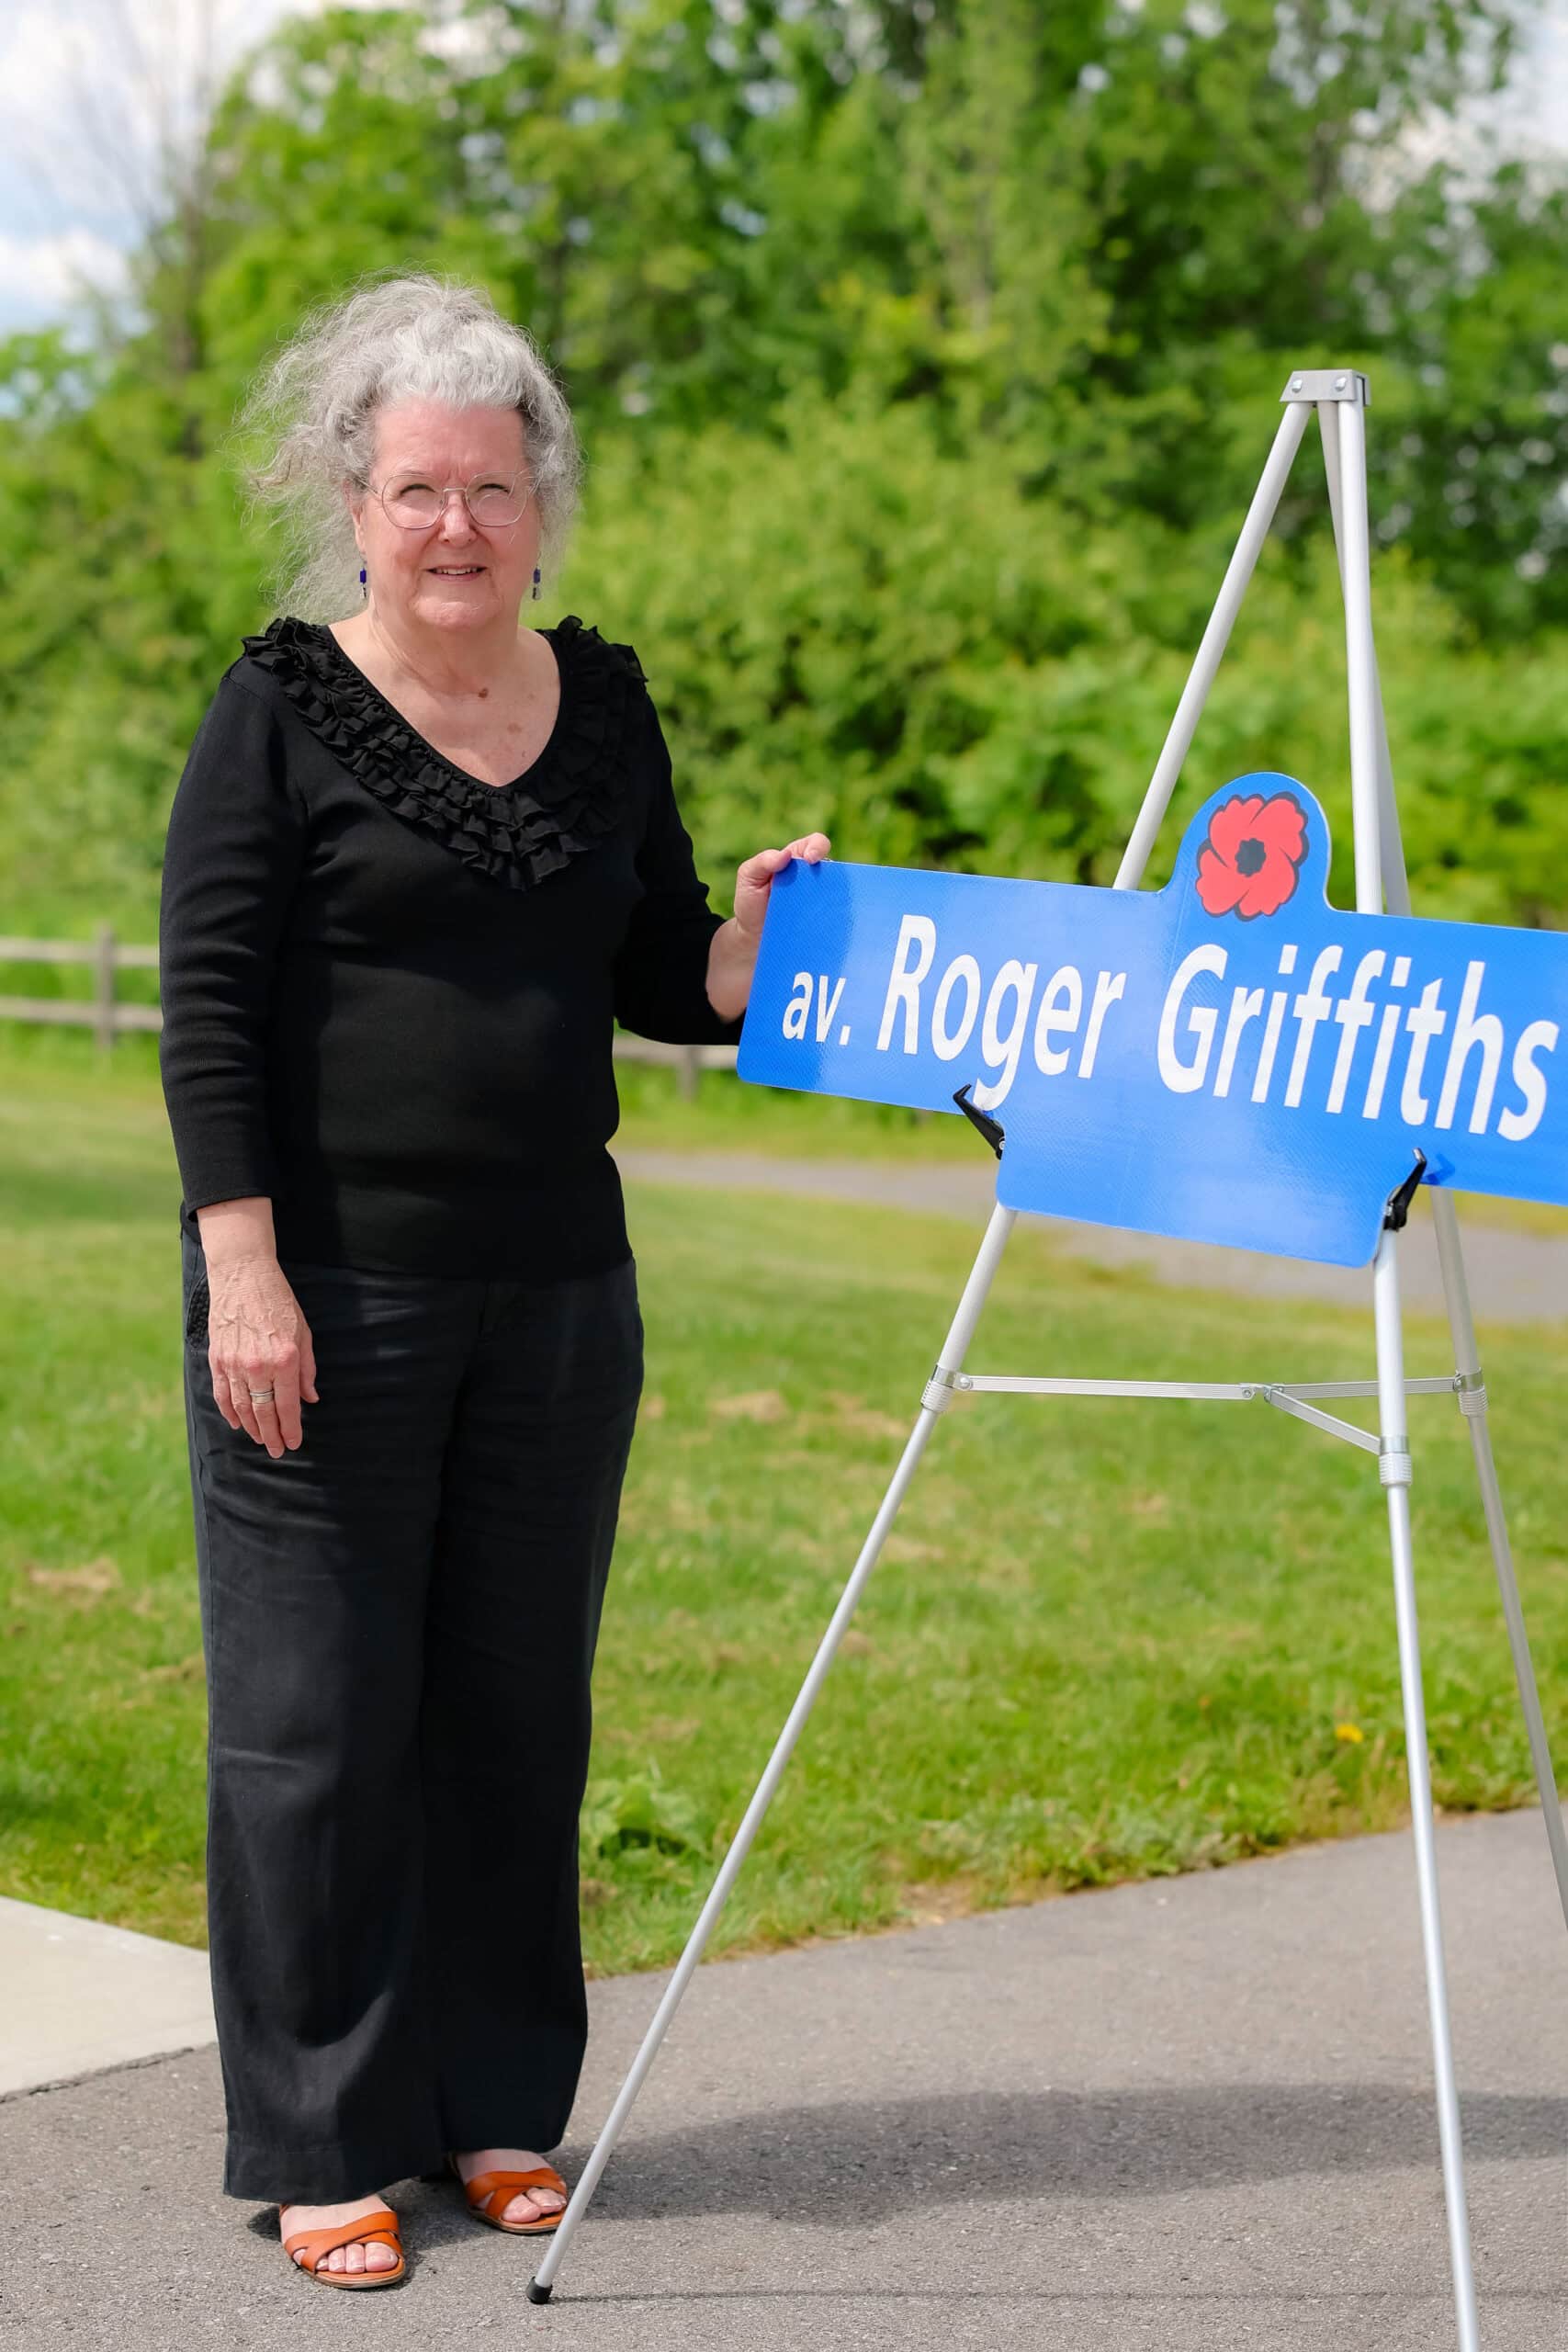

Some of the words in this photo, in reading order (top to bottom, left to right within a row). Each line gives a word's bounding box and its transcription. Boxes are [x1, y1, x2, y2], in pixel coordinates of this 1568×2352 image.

[783, 971, 852, 1046] av.
[875, 914, 1128, 1113] Roger
[1156, 944, 1560, 1141] Griffiths
